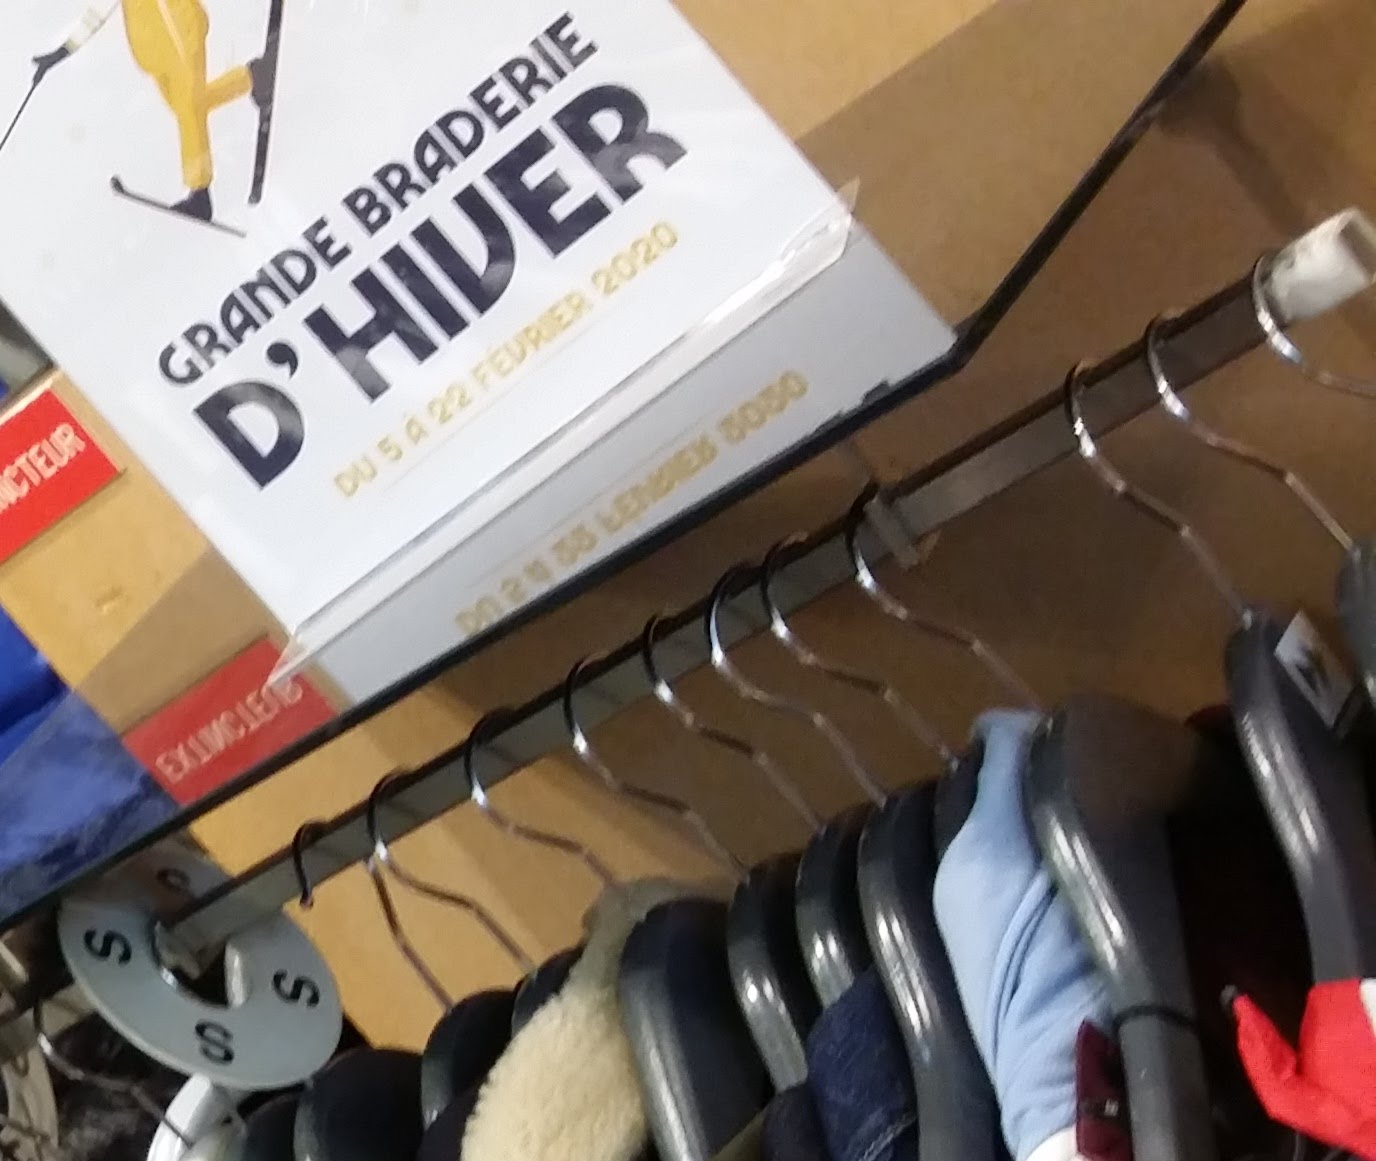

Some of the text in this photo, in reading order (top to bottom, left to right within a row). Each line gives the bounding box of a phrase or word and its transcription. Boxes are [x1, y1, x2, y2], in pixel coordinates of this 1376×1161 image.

[158, 10, 598, 387] GRANDE BRADERIE
[192, 83, 688, 491] D'HIVER
[333, 455, 379, 498] DU
[377, 434, 404, 463] 5
[427, 383, 474, 427] 22
[590, 220, 679, 296] 2020
